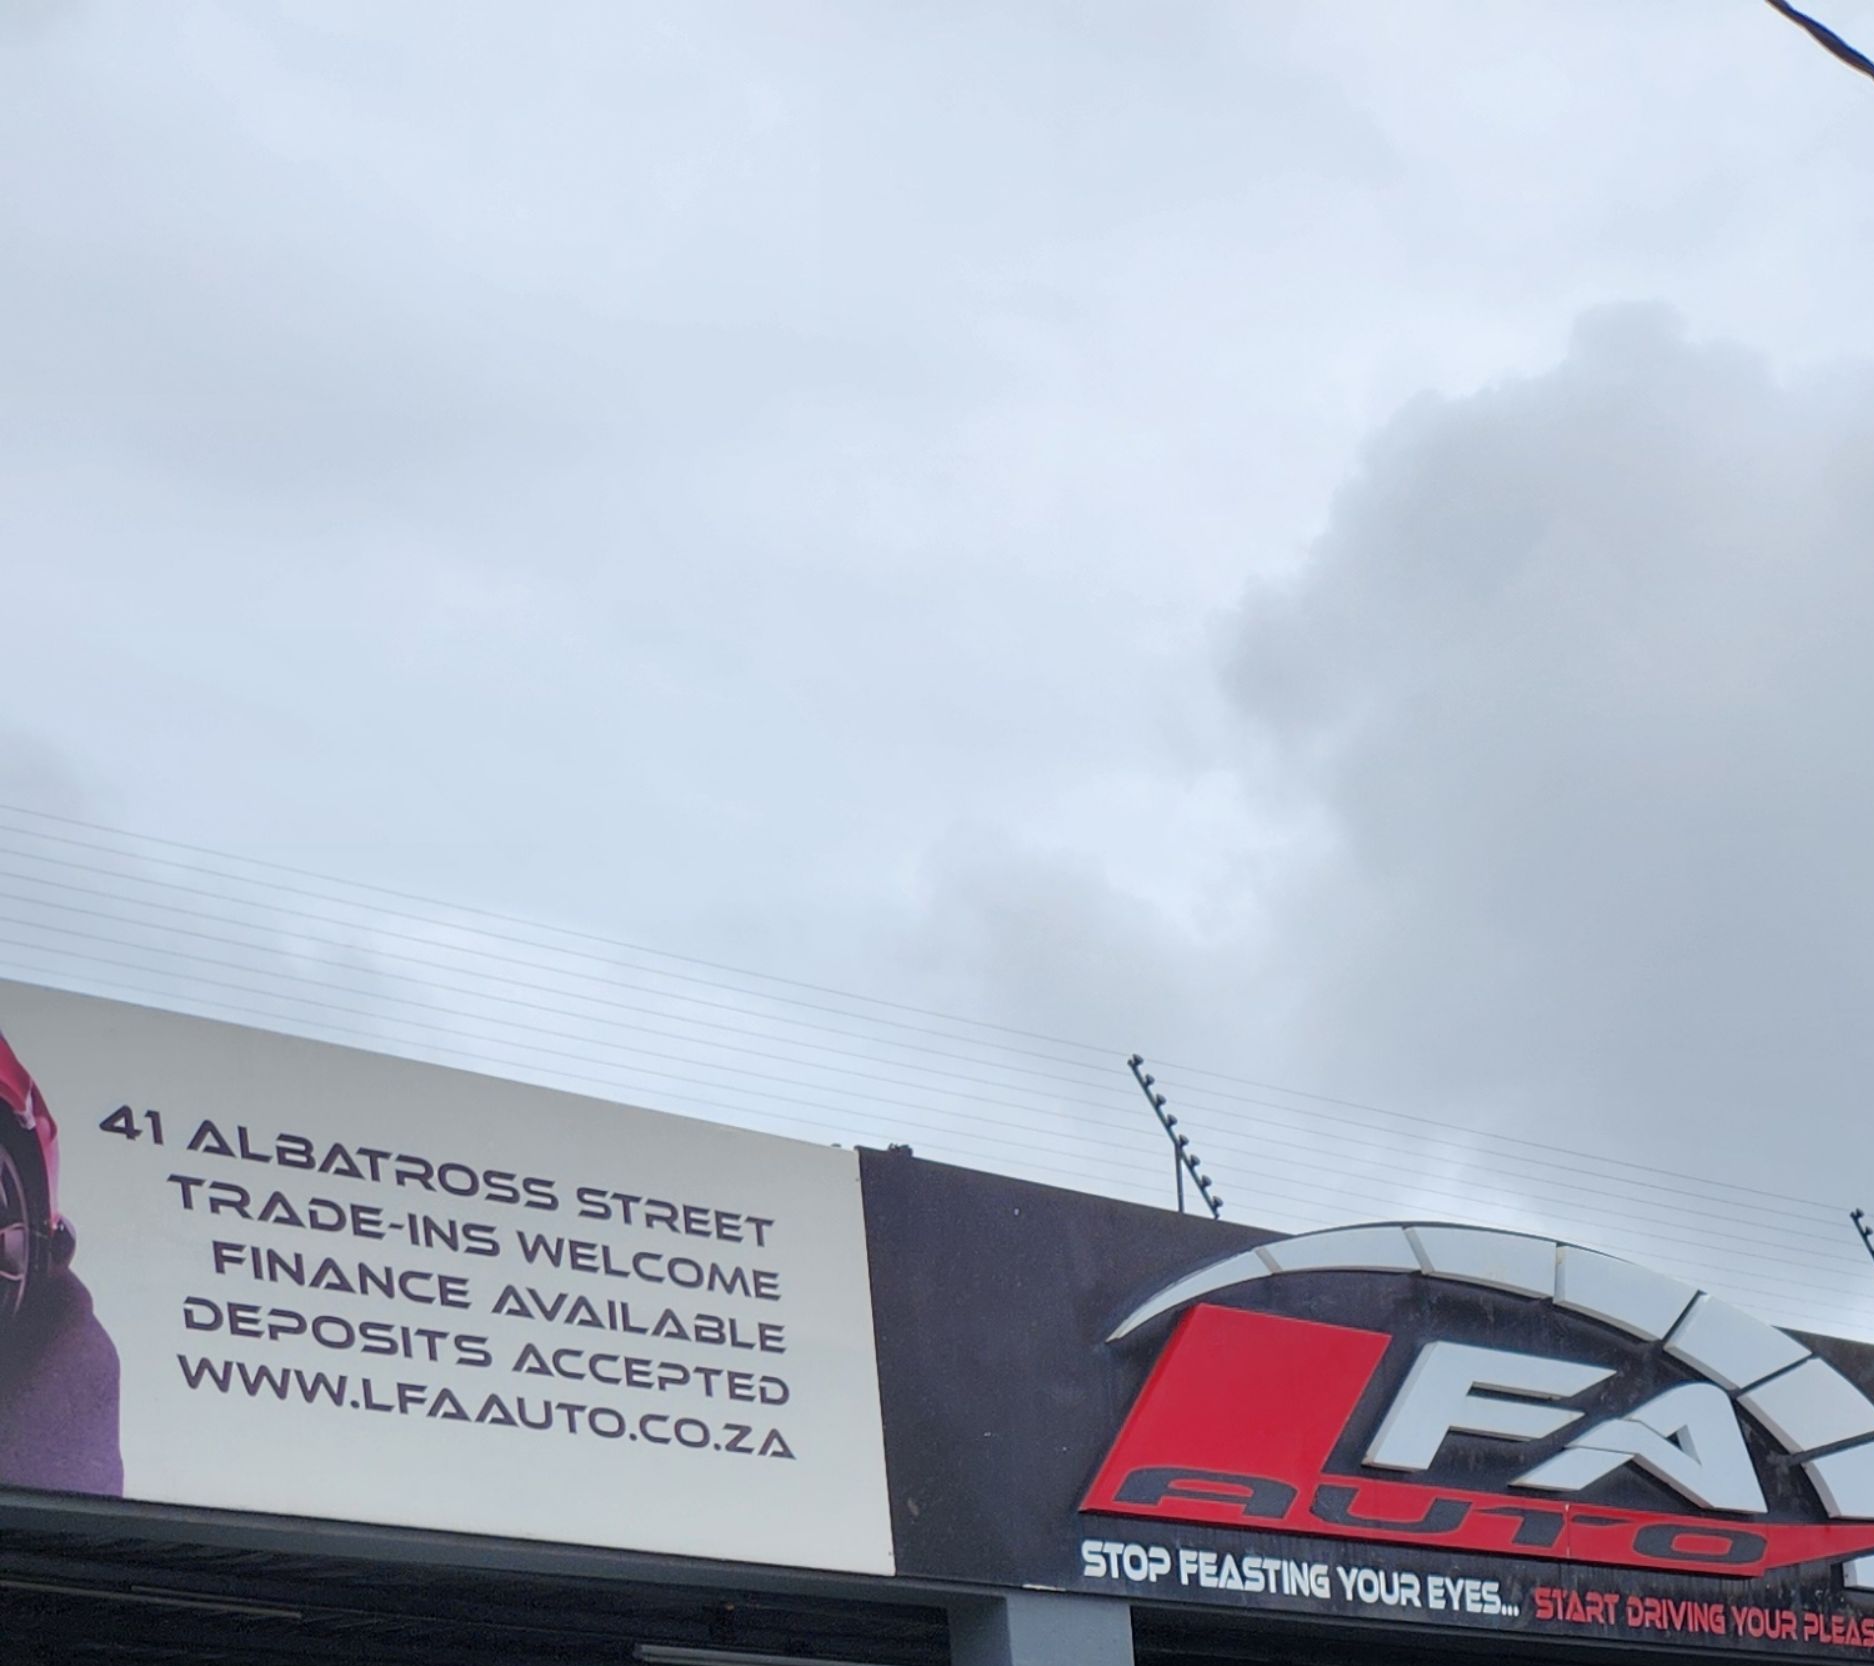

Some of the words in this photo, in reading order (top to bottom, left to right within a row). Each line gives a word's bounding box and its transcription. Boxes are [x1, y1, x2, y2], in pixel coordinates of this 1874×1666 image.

[98, 1104, 165, 1146] 41
[186, 1118, 561, 1212] ALBATROSS
[576, 1186, 776, 1249] STREET
[167, 1173, 502, 1258] TRADE-INS
[517, 1229, 782, 1302] WELCOME
[182, 1294, 493, 1367] DEPOSITS
[512, 1342, 791, 1406] ACCEPTED
[212, 1239, 471, 1310] FINANCE
[491, 1283, 787, 1354] AVAILABLE
[176, 1353, 797, 1461] WWW.LFAAUTO.CO.ZA
[1112, 1465, 1768, 1567] AUTO
[1081, 1540, 1171, 1583] STOP
[1179, 1549, 1331, 1599] FEASTING
[1336, 1567, 1420, 1608] YOUR
[1428, 1576, 1519, 1617] EYES...
[1534, 1587, 1619, 1625] START
[1626, 1595, 1726, 1634] DRIVING
[1731, 1605, 1798, 1640] YOUR
